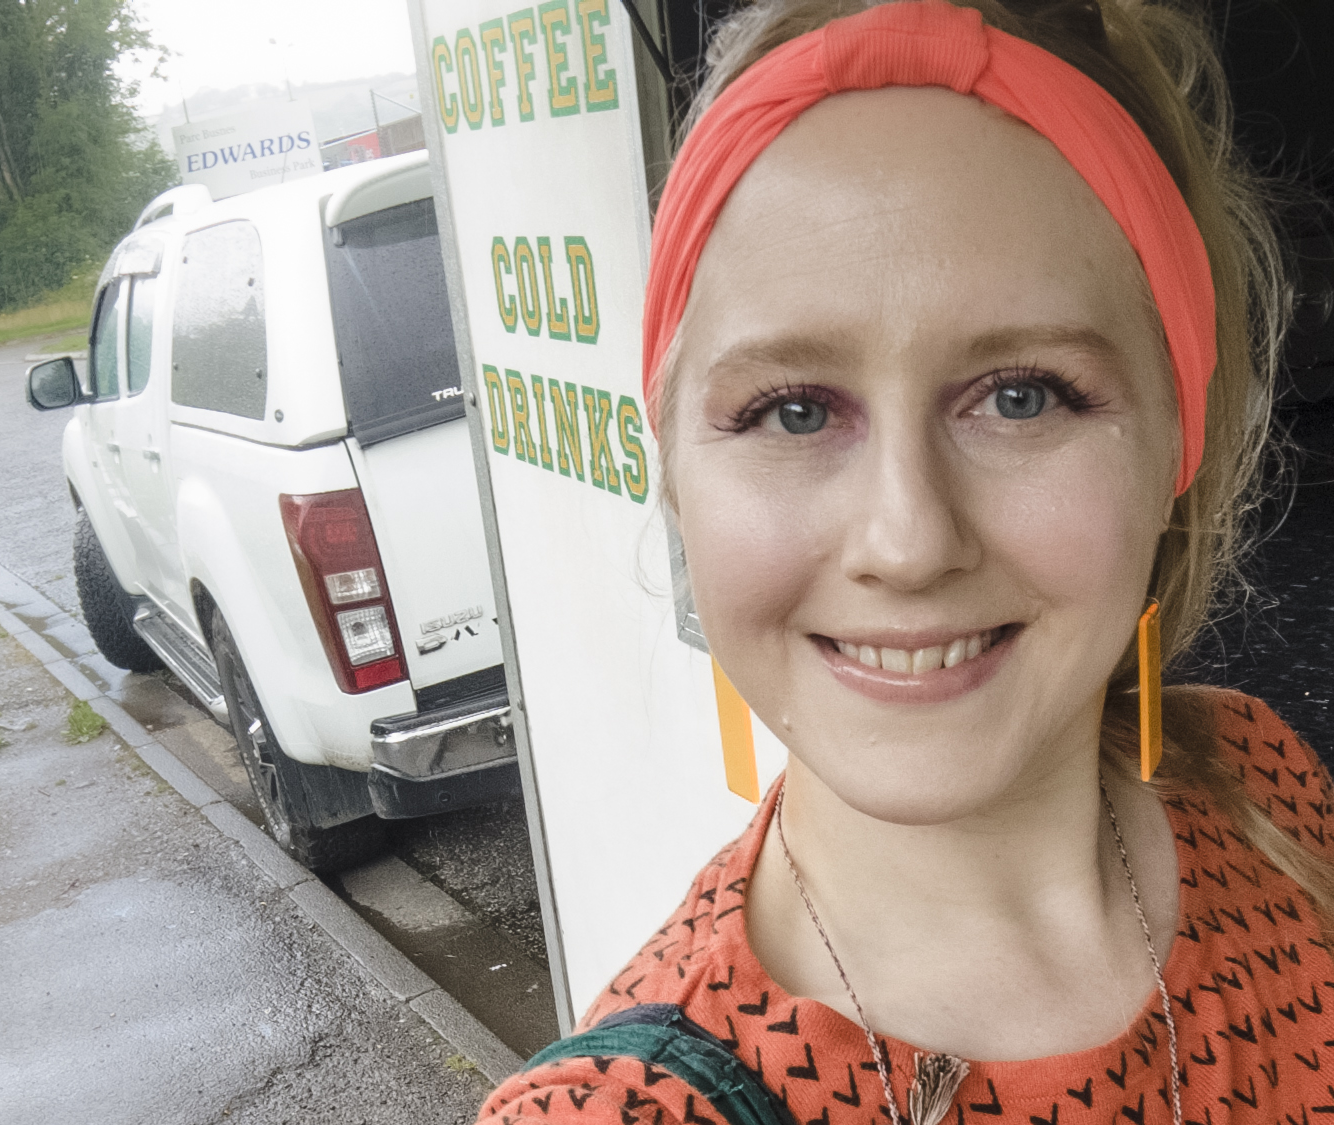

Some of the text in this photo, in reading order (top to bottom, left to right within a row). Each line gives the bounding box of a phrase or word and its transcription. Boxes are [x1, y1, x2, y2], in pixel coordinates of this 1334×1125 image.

[432, 0, 620, 134] COFFEE
[186, 130, 312, 174] EDWARDS
[249, 157, 316, 180] Business Park
[491, 235, 601, 345] COLD
[482, 362, 649, 505] DRINKS
[419, 605, 484, 635] ISUZU
